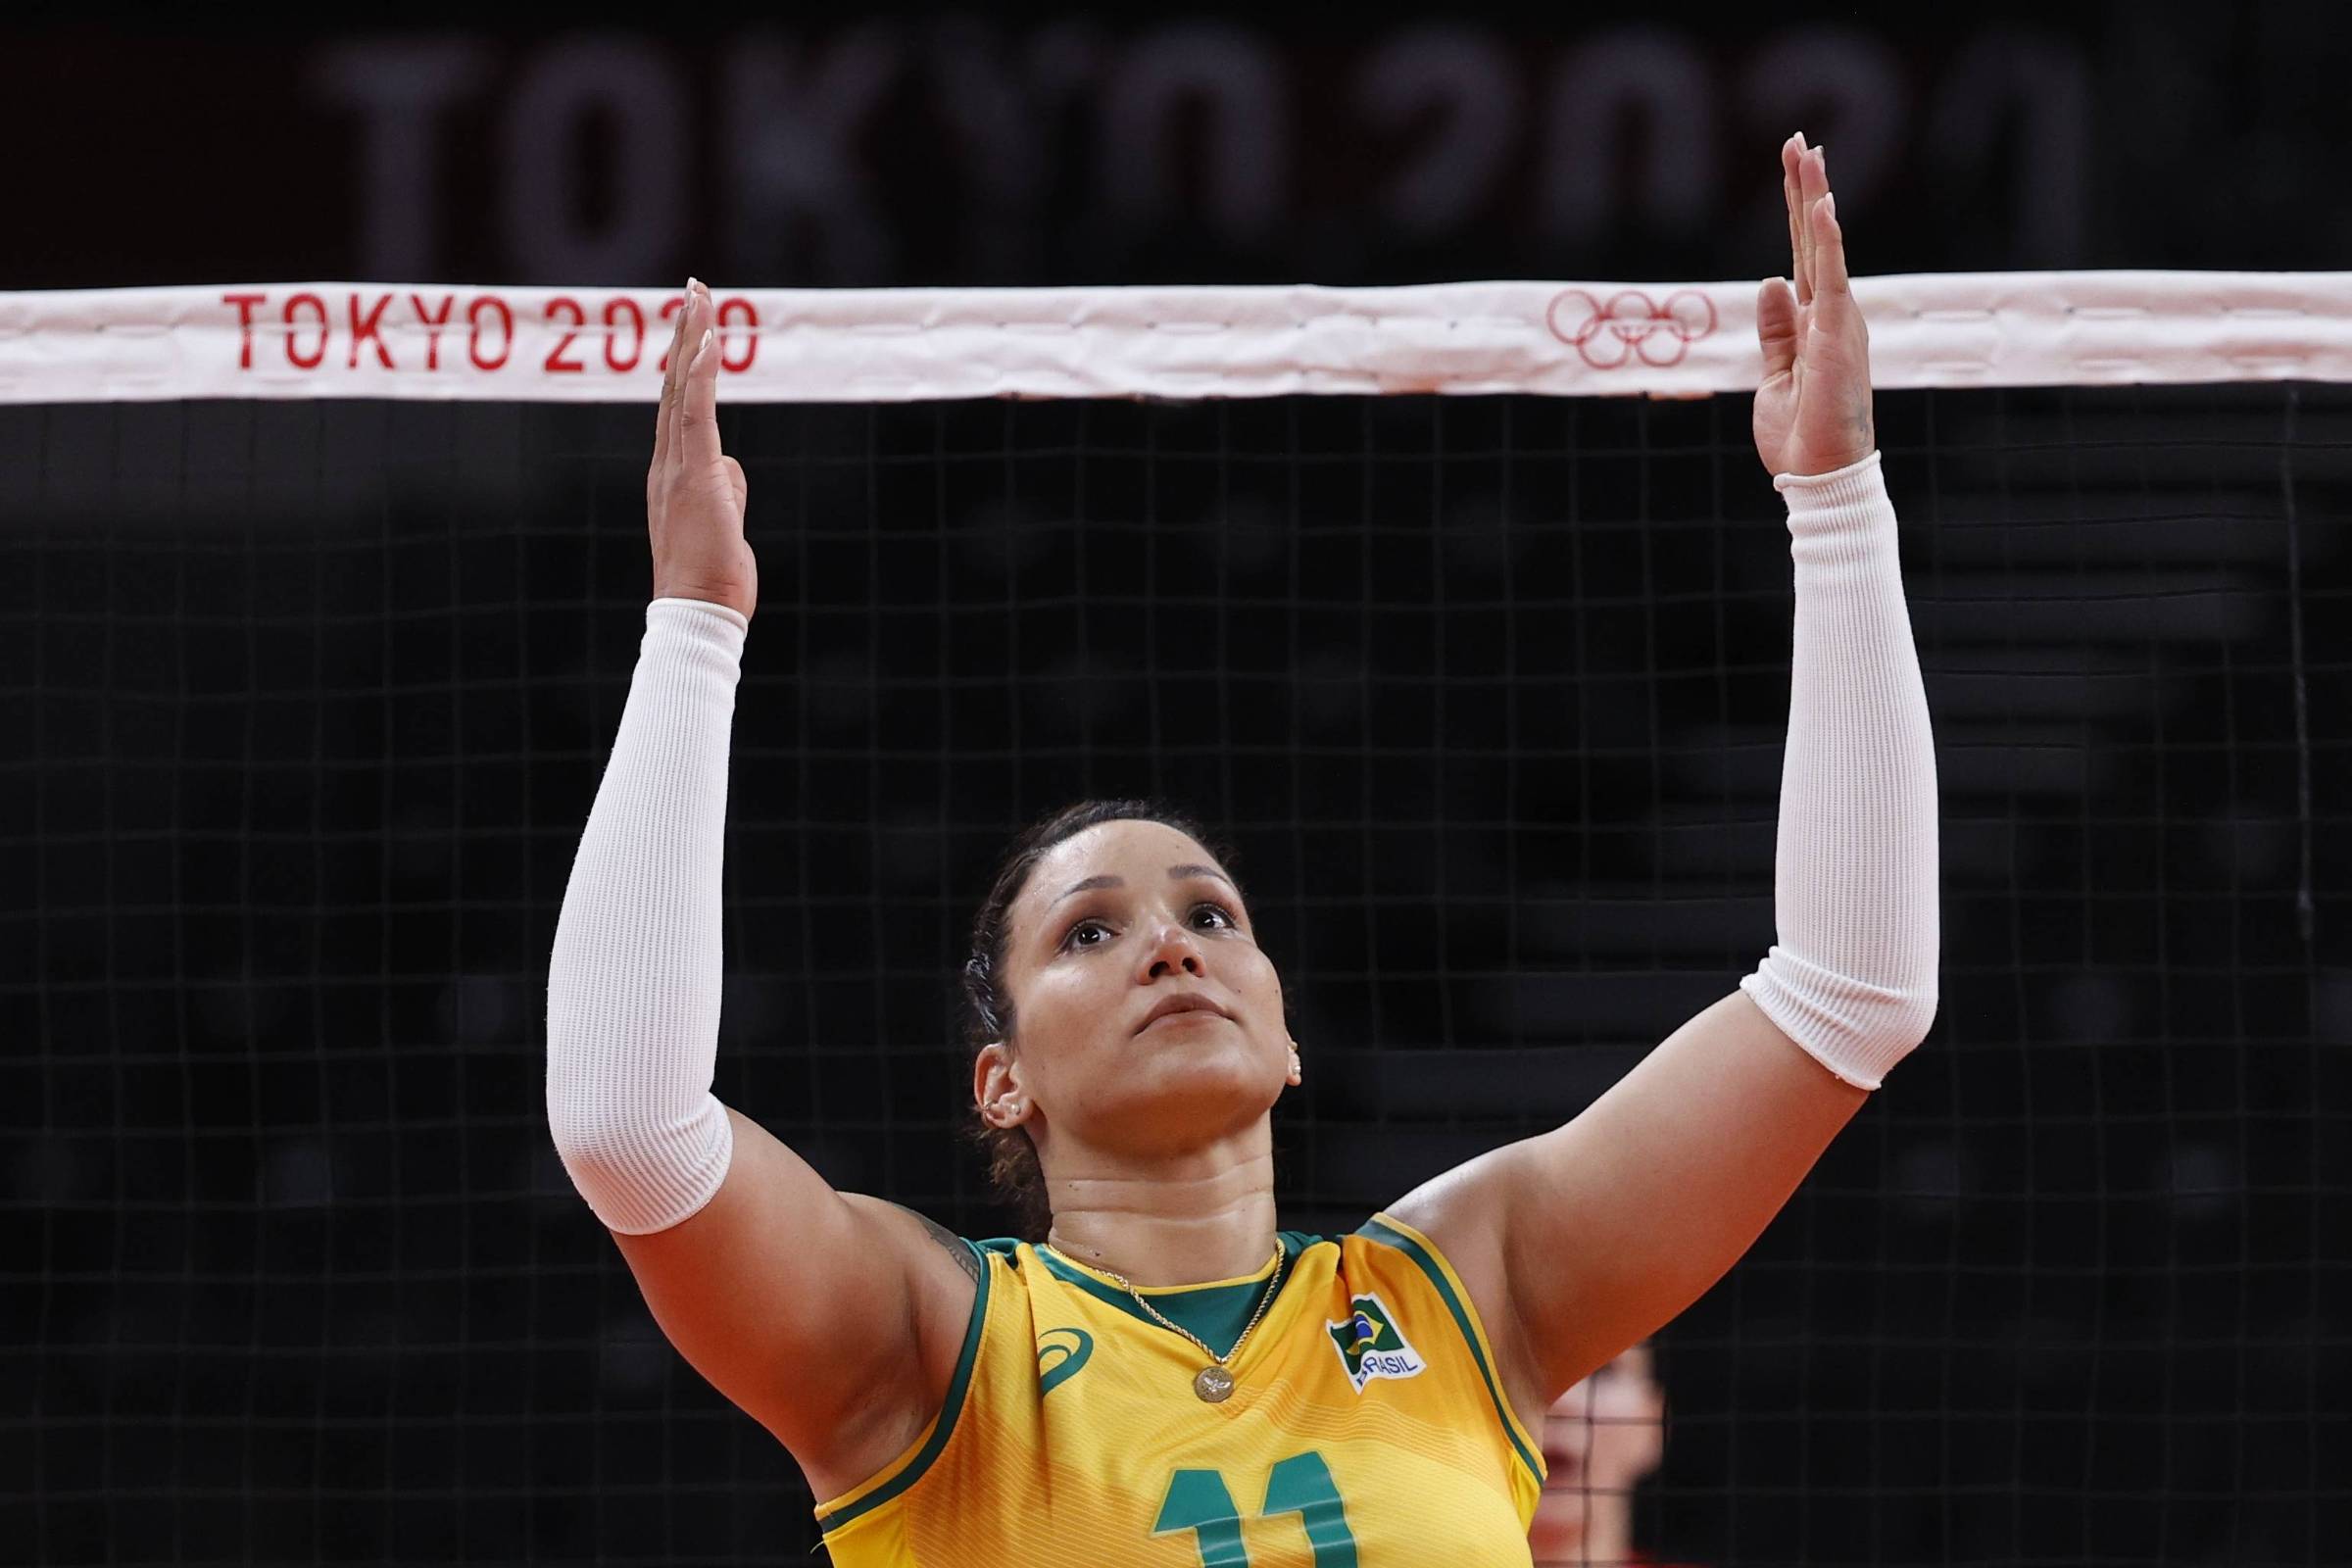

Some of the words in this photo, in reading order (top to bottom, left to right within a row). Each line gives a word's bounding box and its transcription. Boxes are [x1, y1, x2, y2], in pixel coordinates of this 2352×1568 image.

[306, 22, 1288, 285] TOKYO
[223, 293, 514, 372] TOKYO
[1152, 1451, 1358, 1568] 11
